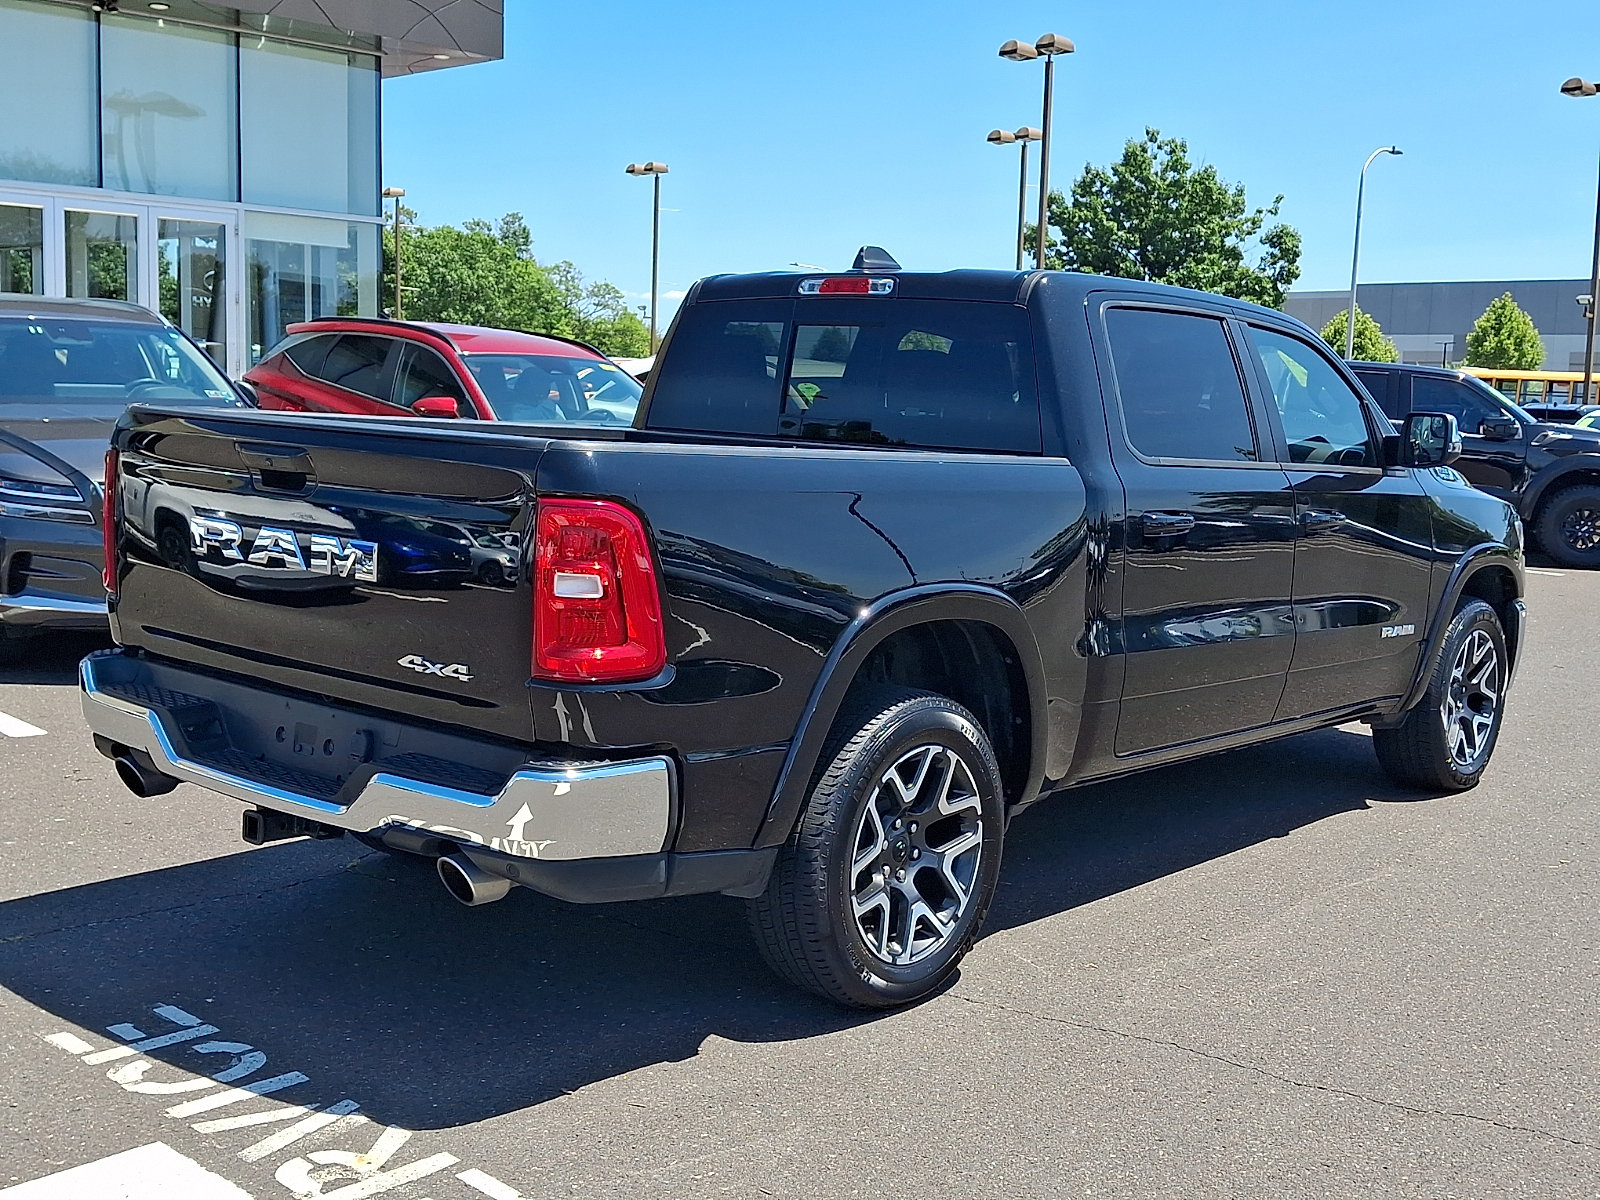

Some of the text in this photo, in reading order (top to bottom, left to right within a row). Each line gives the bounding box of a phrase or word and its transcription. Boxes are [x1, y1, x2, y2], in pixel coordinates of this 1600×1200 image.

[189, 515, 379, 582] RAM
[1381, 624, 1415, 639] RAM
[397, 653, 475, 683] 4x4
